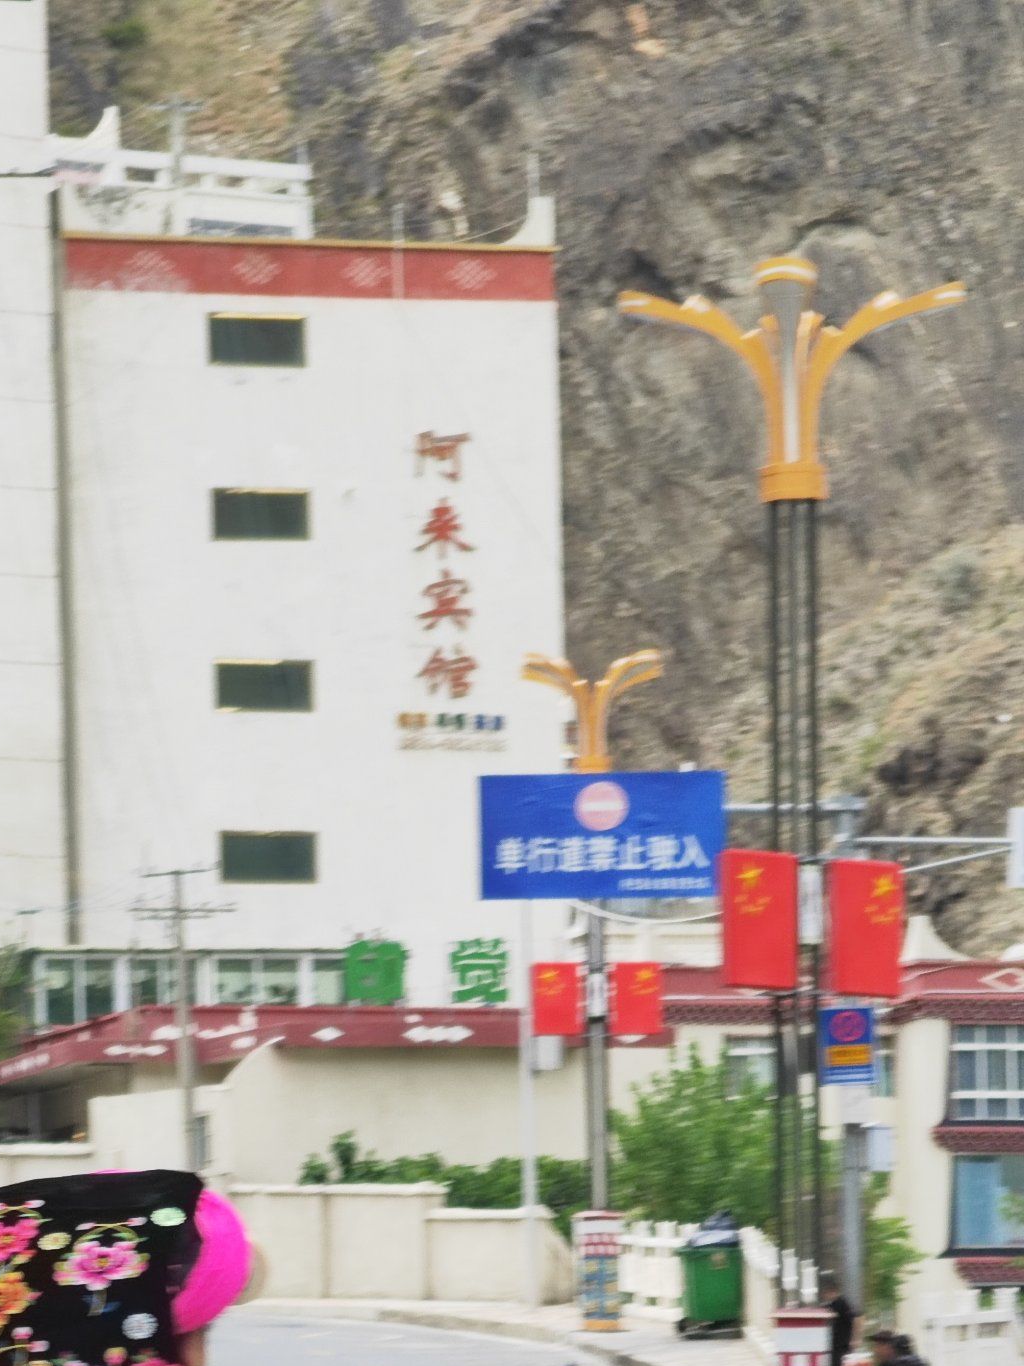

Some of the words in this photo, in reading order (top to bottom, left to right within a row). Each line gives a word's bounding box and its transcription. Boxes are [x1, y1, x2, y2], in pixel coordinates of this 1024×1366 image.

[494, 835, 712, 873] 单行道禁止驶入
